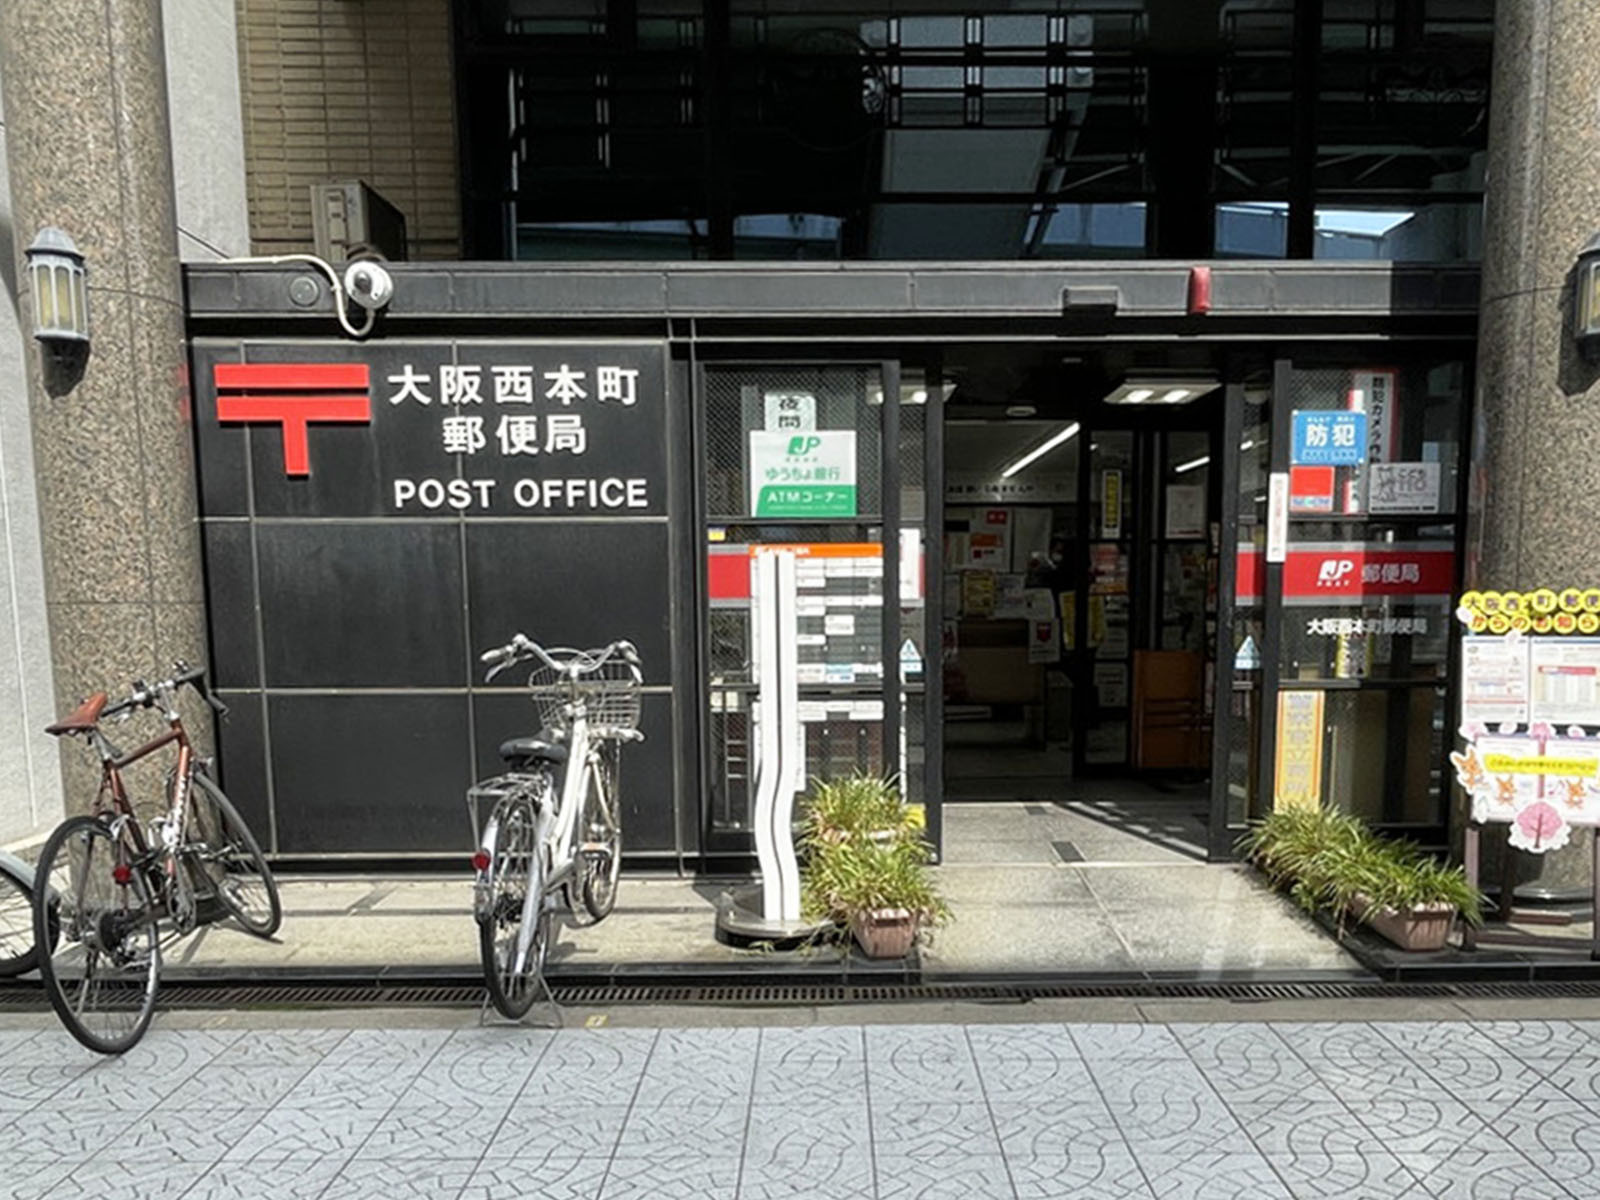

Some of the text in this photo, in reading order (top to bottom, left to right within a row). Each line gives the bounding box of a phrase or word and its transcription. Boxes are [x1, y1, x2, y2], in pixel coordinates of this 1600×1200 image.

[387, 364, 639, 406] 大阪西本町
[442, 414, 588, 455] 郵便局
[1305, 424, 1356, 447] 防犯
[787, 436, 821, 456] JP
[765, 466, 841, 481] ゆうちょ銀行
[394, 478, 648, 508] POST OFFICE
[767, 491, 848, 503] ATMコーナー
[1318, 560, 1354, 580] JP
[1361, 562, 1421, 584] 郵便局
[1306, 617, 1428, 635] 大阪西本町郵便局
